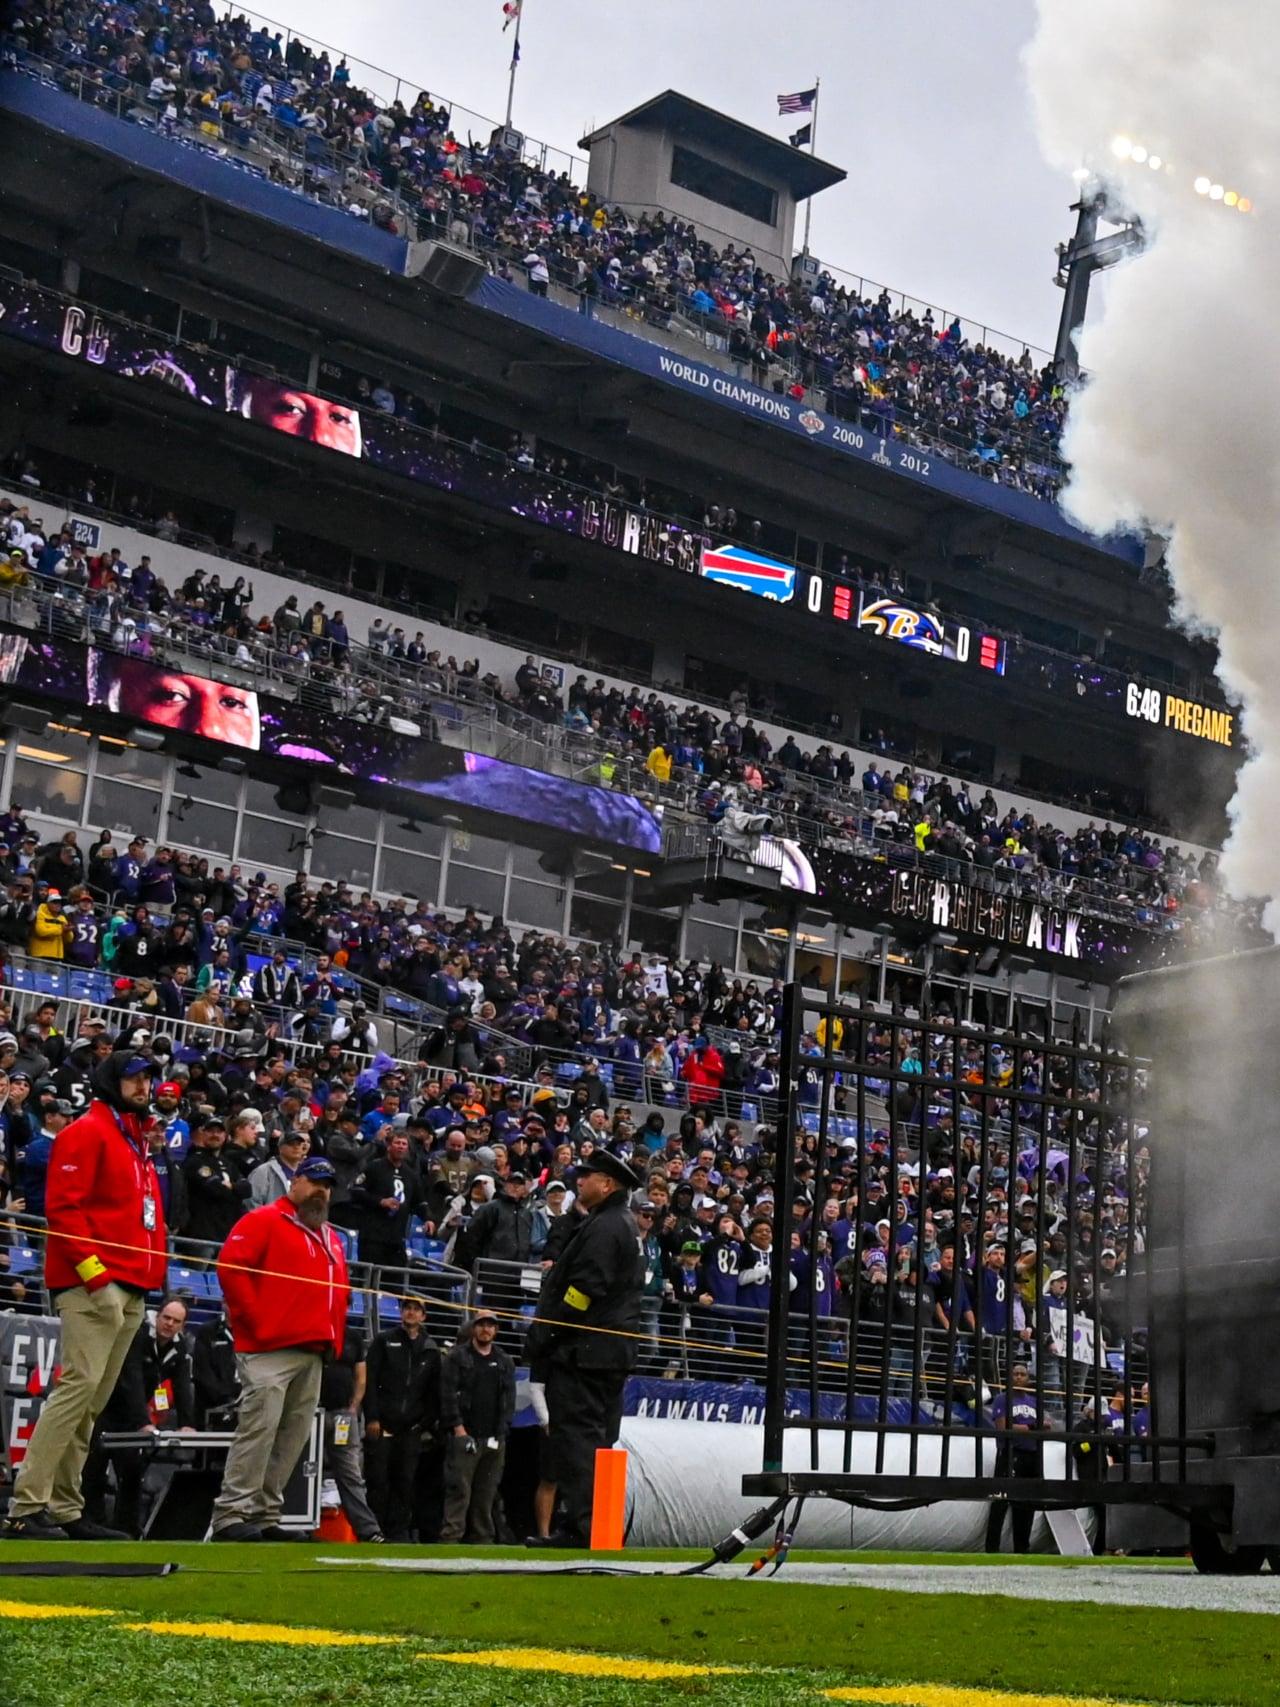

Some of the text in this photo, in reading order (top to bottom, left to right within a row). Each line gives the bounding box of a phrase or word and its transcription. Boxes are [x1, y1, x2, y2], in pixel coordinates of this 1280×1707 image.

[62, 306, 109, 364] CB
[659, 355, 709, 388] WORLD
[713, 378, 790, 420] CHAMPIONS
[832, 425, 863, 449] 2000
[900, 453, 930, 476] 2012
[74, 523, 94, 545] 224
[807, 575, 823, 613] 0
[956, 626, 970, 663] 0
[1126, 682, 1233, 747] 6:48 PREGAME
[891, 870, 1082, 958] CORNERBACK
[77, 923, 98, 943] 52
[137, 941, 148, 956] 8
[654, 978, 662, 989] 7
[394, 1180, 405, 1204] 8
[847, 1231, 856, 1249] 8
[717, 1248, 739, 1275] 82
[996, 1278, 1005, 1302] 8
